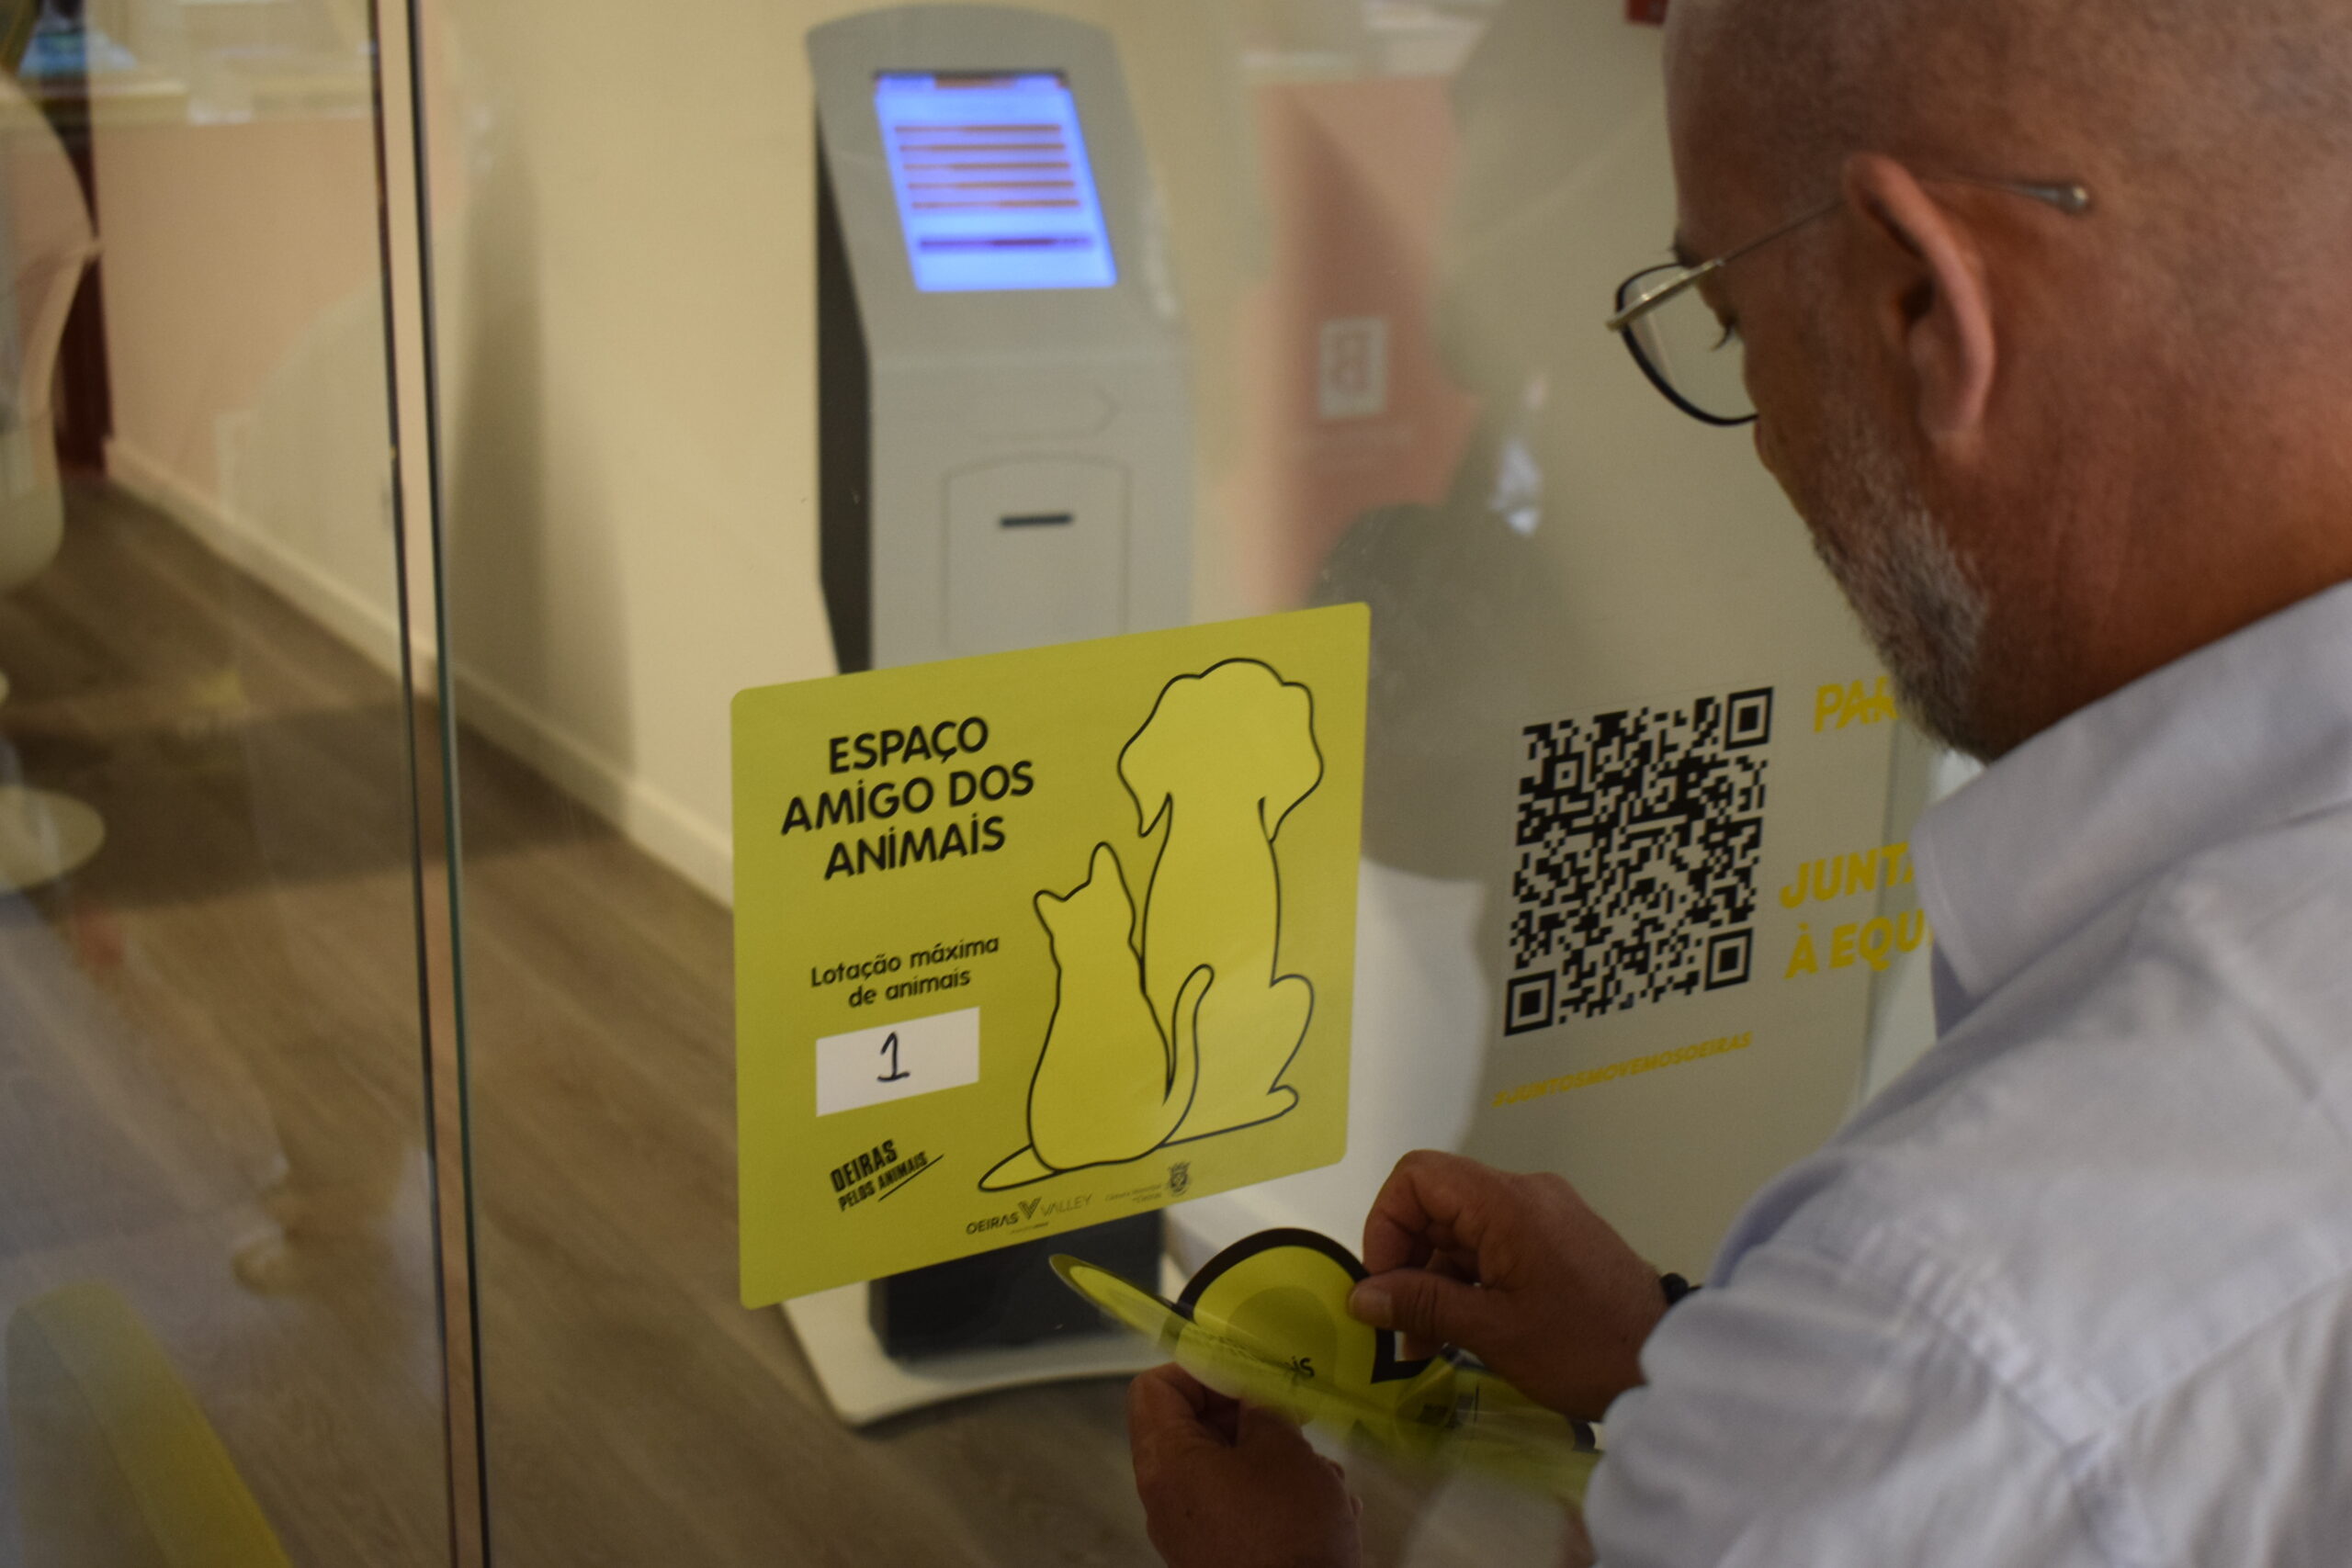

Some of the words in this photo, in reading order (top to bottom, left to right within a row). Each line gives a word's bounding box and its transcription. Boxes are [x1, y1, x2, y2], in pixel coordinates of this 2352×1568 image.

[830, 716, 989, 774] ESPAÇO
[948, 760, 1034, 807] DOS
[810, 953, 902, 987] Lotação
[910, 937, 1000, 969] máxima
[1784, 921, 1818, 979] À
[1828, 908, 1934, 971] EQU
[848, 986, 877, 1008] de
[885, 967, 971, 1000] animais
[876, 1032, 910, 1082] 1
[831, 1139, 898, 1193] OEIRAS
[966, 1212, 1020, 1235] OEIRAS
